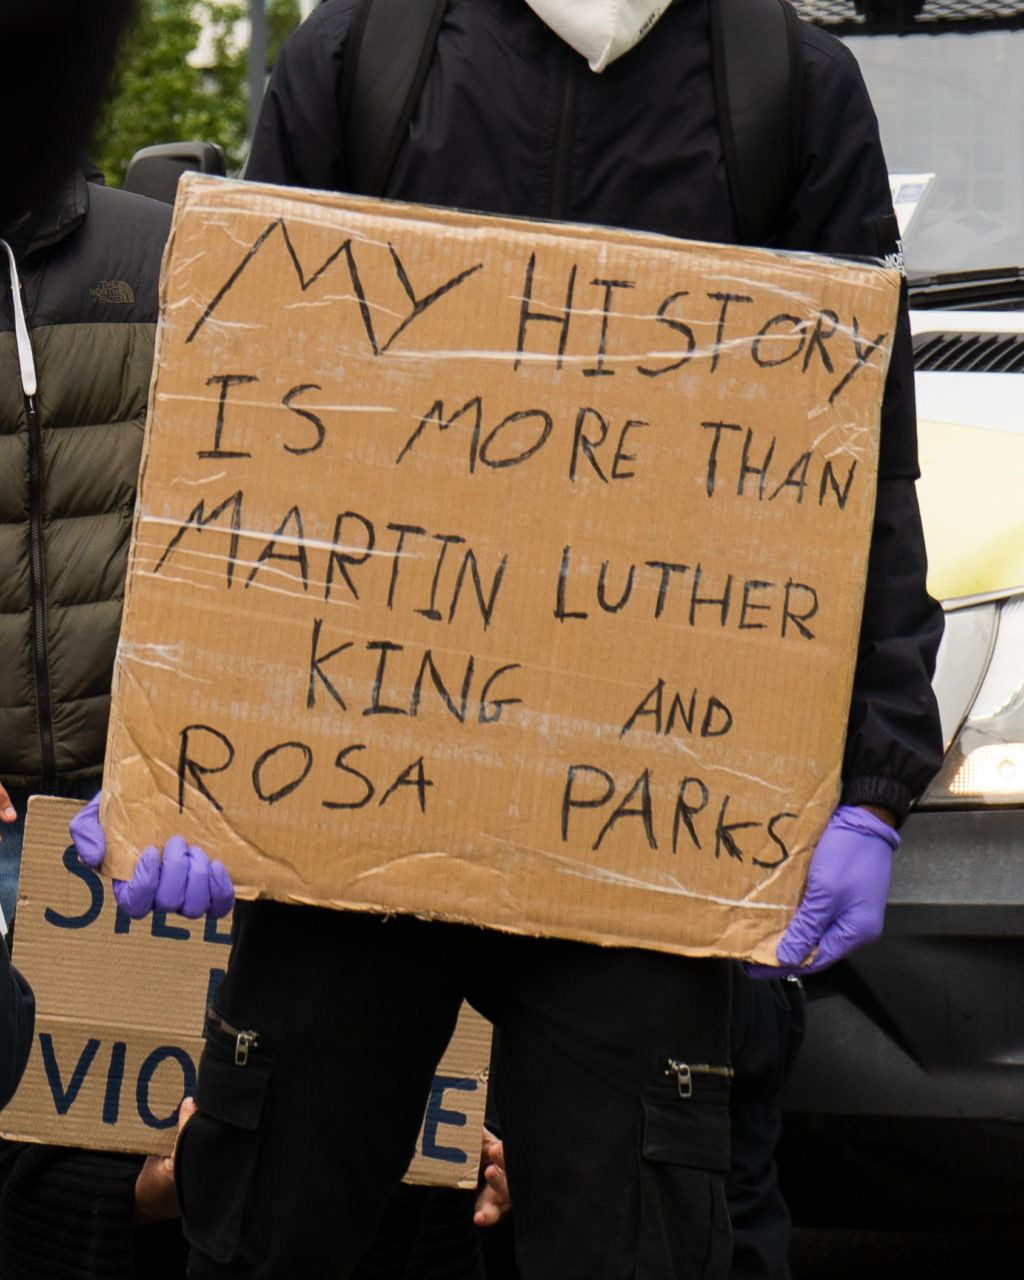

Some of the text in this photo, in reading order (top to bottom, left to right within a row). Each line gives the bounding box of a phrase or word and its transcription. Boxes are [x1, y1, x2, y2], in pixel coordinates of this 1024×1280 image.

[184, 217, 888, 407] MY HISTORY
[195, 373, 858, 511] IS MORE THAN
[152, 489, 819, 641] MARTIN LUTHER
[306, 617, 733, 740] KING AND
[177, 723, 799, 870] ROSA PARKS
